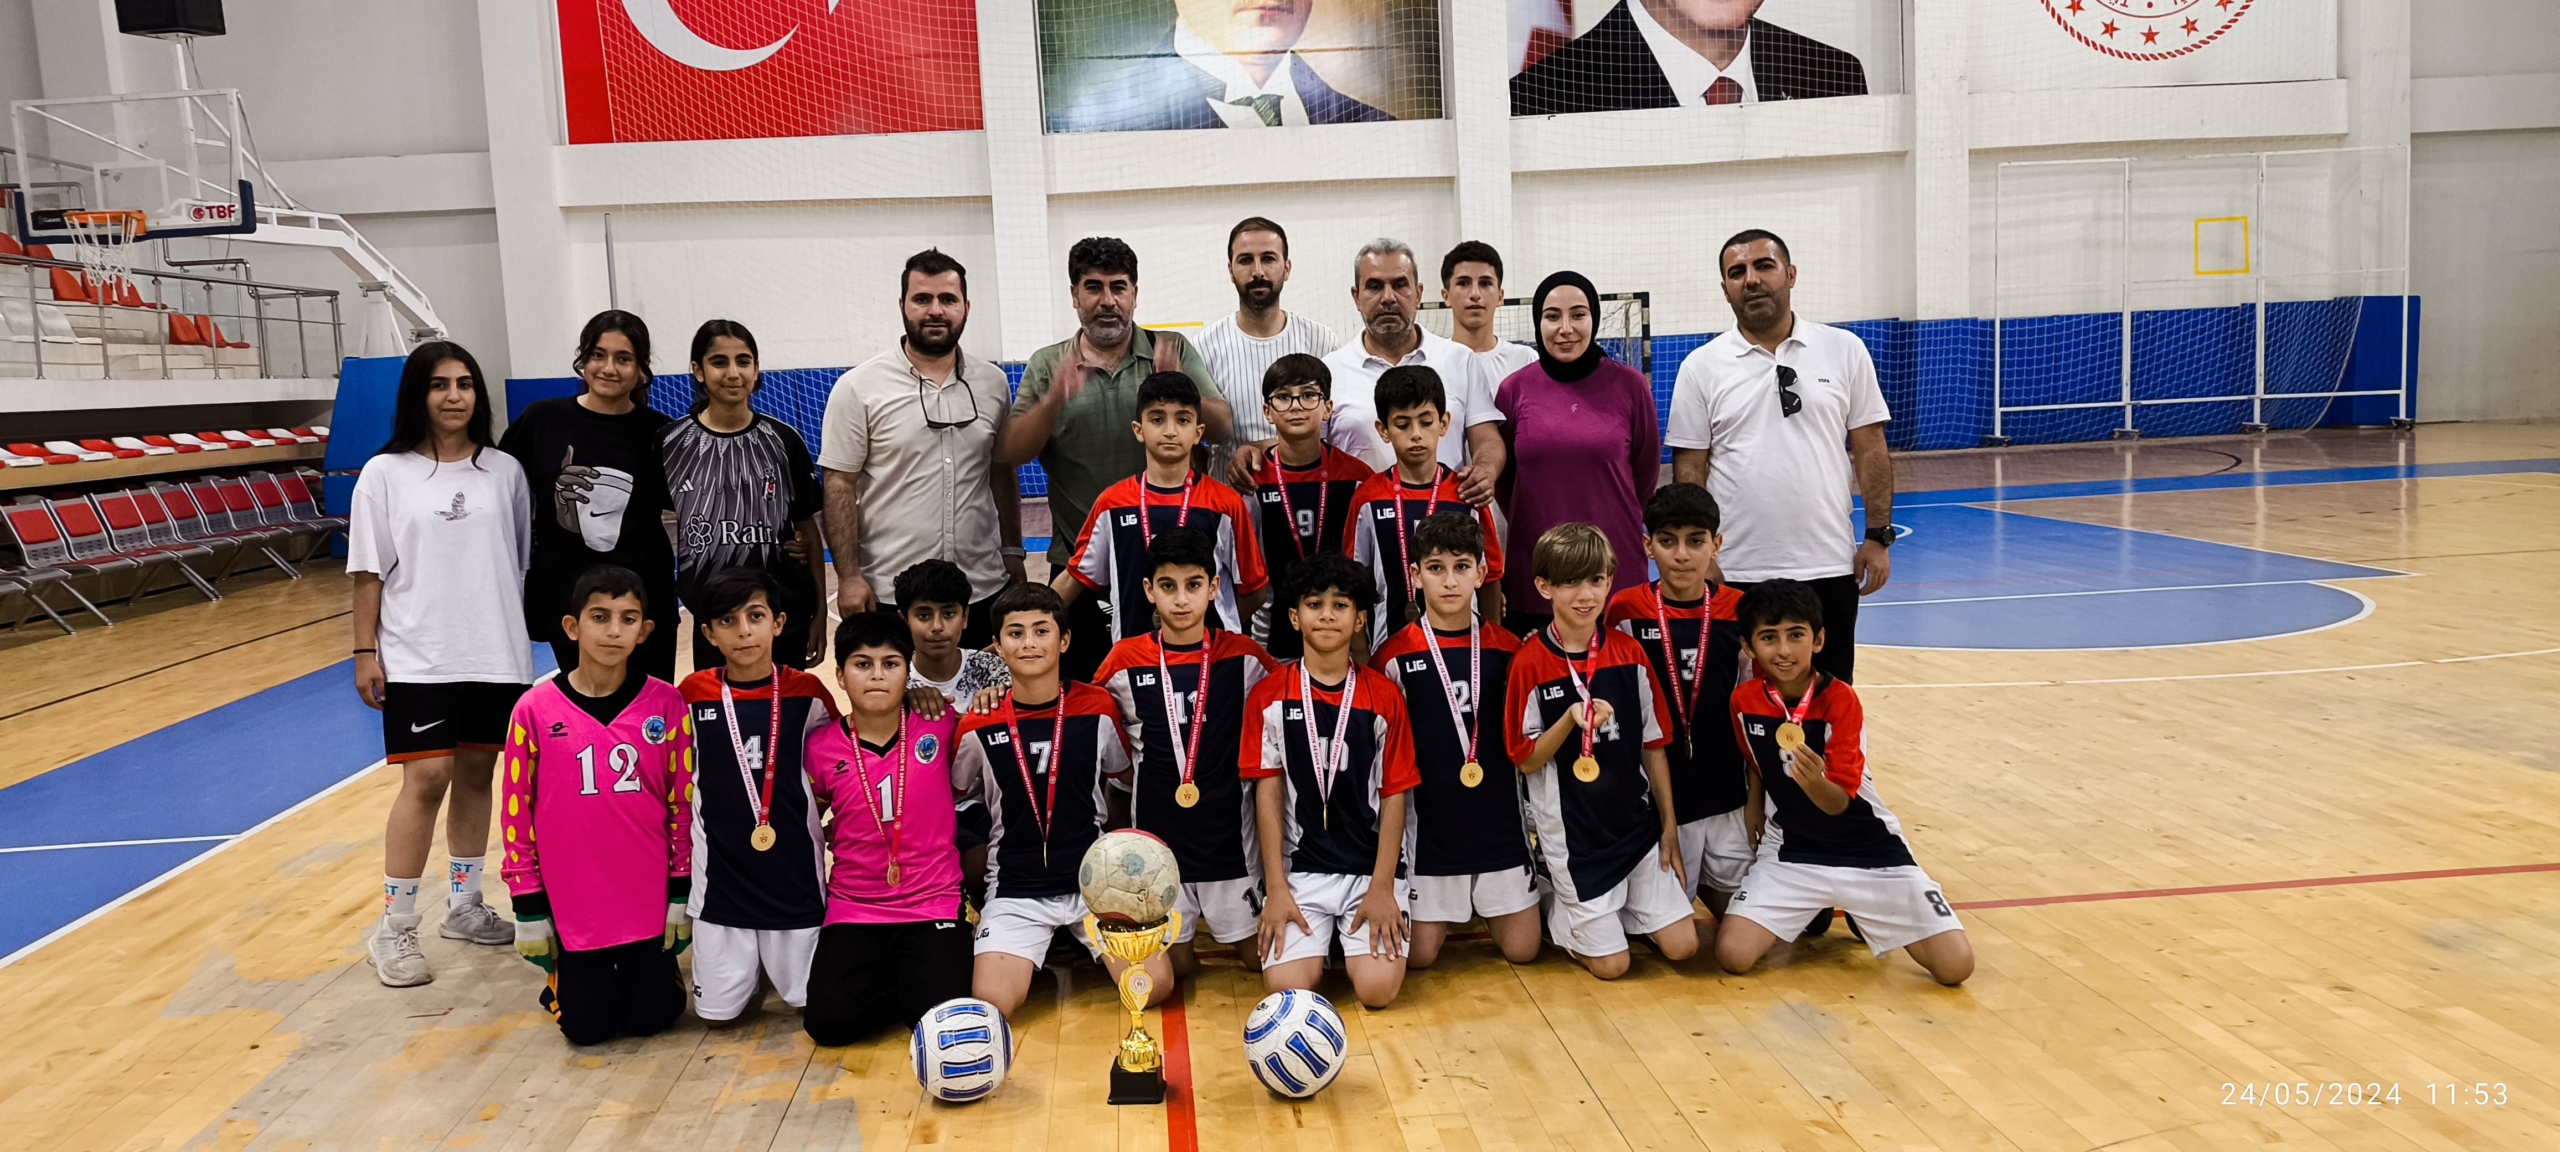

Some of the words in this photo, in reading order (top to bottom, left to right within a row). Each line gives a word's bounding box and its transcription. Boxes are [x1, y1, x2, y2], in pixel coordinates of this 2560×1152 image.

[205, 205, 236, 221] TBF
[1296, 509, 1314, 536] 9
[1681, 648, 1698, 681] 3
[1173, 690, 1207, 724] 11
[1194, 701, 1203, 723] GENÇLİK
[1451, 680, 1472, 713] 2
[743, 735, 763, 770] 4
[767, 736, 776, 765] BAKANLIĞI
[1030, 740, 1052, 774] 7
[1188, 724, 1199, 757] CUMHURİYETİ
[576, 742, 641, 796] 12
[856, 759, 865, 772] SPOR
[1185, 758, 1193, 779] TÜRKİYE
[876, 773, 895, 823] 1
[1923, 890, 1953, 917] 8
